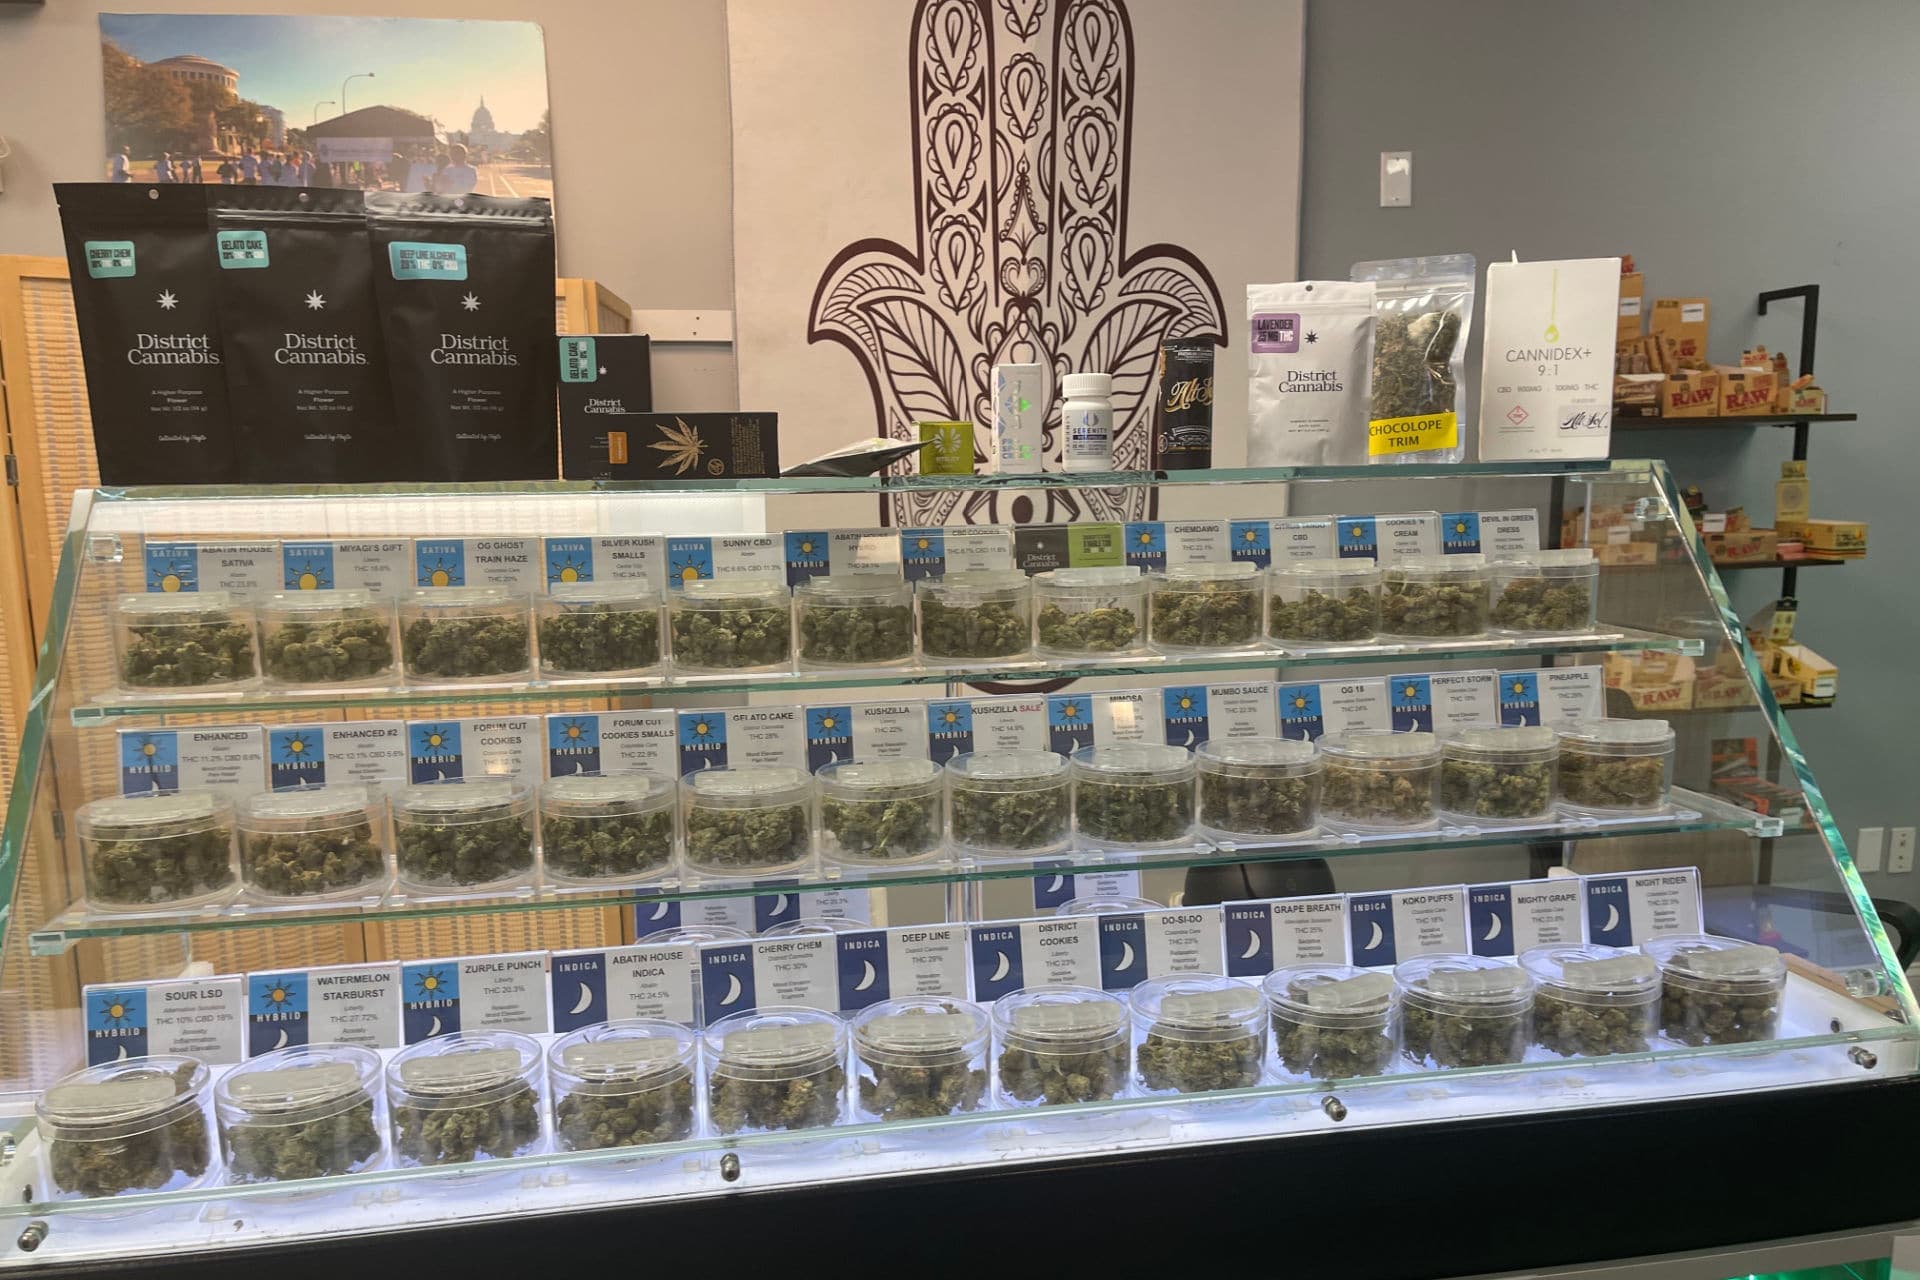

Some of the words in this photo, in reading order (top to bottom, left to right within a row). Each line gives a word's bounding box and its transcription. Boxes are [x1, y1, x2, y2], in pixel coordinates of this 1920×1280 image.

[222, 241, 244, 250] GELATO
[247, 240, 263, 249] CAKE
[1257, 320, 1293, 329] LAVENDER
[285, 333, 357, 349] District
[1280, 331, 1294, 341] THC
[137, 334, 210, 350] District
[441, 334, 509, 351] District
[127, 349, 220, 365] Cannabis
[275, 349, 366, 365] Cannabis
[431, 349, 517, 365] Cannabis
[1506, 348, 1591, 362] CANNIDEX+
[1538, 364, 1559, 376] 9:1
[1287, 370, 1337, 382] District
[1278, 381, 1343, 393] Cannabis
[1672, 387, 1715, 408] RAW
[1726, 387, 1771, 409] RAW
[1369, 419, 1442, 436] CHOCOLOPE
[1388, 436, 1419, 447] TRIM
[477, 542, 491, 550] OG
[493, 541, 524, 549] GHOST
[601, 539, 630, 547] SILVER
[723, 539, 752, 547] SUNNY
[754, 538, 772, 546] CBD
[288, 549, 325, 557] SATIVA
[382, 544, 403, 552] GIFT
[551, 544, 585, 552] SATIVA
[1727, 541, 1762, 559] RAW
[151, 549, 190, 558] SATIVA
[612, 552, 645, 560] SMALLS
[1027, 553, 1056, 562] District
[1130, 551, 1161, 559] HYBRID
[221, 559, 254, 567] SATIVA
[475, 556, 502, 564] TRAIN
[504, 555, 528, 563] HAZE
[791, 560, 824, 568] HYBRID
[908, 557, 940, 565] HYBRID
[1023, 560, 1059, 568] Cannabis
[1432, 677, 1465, 685] PERFECT
[1212, 688, 1241, 696] MUMBO
[1242, 686, 1269, 694] SAUCE
[1643, 687, 1682, 705] RAW
[971, 705, 1018, 714] KUSHZILLA
[1019, 703, 1041, 712] SALE
[1504, 701, 1534, 709] HYBRID
[865, 707, 910, 716] KUSHZILLA
[733, 714, 767, 722] GELATO
[769, 712, 794, 720] CAKE
[1171, 716, 1203, 724] HYBRID
[1286, 716, 1317, 724] HYBRID
[474, 723, 507, 732] FORUM
[509, 722, 527, 730] CUT
[194, 732, 248, 742] ENHANCED
[333, 730, 385, 740] ENHANCED
[387, 729, 398, 737] #2
[602, 731, 640, 739] COOKIES
[642, 730, 674, 738] SMALLS
[935, 731, 968, 740] HYBRID
[481, 737, 522, 746] COOKIES
[813, 736, 848, 745] HYBRID
[556, 747, 593, 755] HYBRID
[685, 743, 720, 751] HYBRID
[417, 755, 456, 764] HYBRID
[129, 764, 171, 774] HYBRID
[278, 761, 318, 770] HYBRID
[1635, 878, 1661, 887] NIGHT
[1662, 876, 1687, 884] RIDER
[1591, 886, 1623, 895] INDICA
[1402, 896, 1426, 905] KOKO
[1427, 894, 1454, 902] PUFFS
[1474, 894, 1505, 903] INDICA
[1517, 895, 1548, 904] MIGHTY
[1550, 894, 1577, 902] GRAPE
[1274, 905, 1304, 914] GRAPE
[1306, 903, 1341, 912] BREATH
[1353, 903, 1386, 912] INDICA
[1162, 915, 1202, 924] DO-SI-DO
[1232, 912, 1265, 920] INDICA
[1038, 922, 1077, 932] DISTRICT
[1105, 923, 1138, 932] INDICA
[902, 933, 927, 942] DEEP
[929, 931, 950, 940] LINE
[979, 932, 1013, 942] INDICA
[1039, 936, 1079, 946] COOKIES
[758, 943, 795, 954] CHERRY
[796, 941, 822, 949] CHEM
[845, 940, 880, 950] INDICA
[612, 954, 648, 964] ABATIN
[650, 951, 683, 961] HOUSE
[709, 954, 746, 964] INDICA
[465, 962, 505, 974] ZURPLE
[507, 960, 542, 970] PUNCH
[559, 962, 598, 972] INDICA
[775, 964, 791, 972] THC
[632, 968, 664, 978] INDICA
[317, 974, 390, 985] WATERMELON
[165, 990, 198, 1001] SOUR
[200, 989, 223, 999] LSD
[323, 989, 385, 1000] STARBURST
[630, 992, 648, 1000] THC
[410, 999, 452, 1009] HYBRID
[156, 1017, 173, 1025] THC
[195, 1015, 215, 1023] CBD
[256, 1012, 301, 1022] HYBRID
[331, 1015, 348, 1023] THC
[95, 1028, 140, 1038] HYBRID
